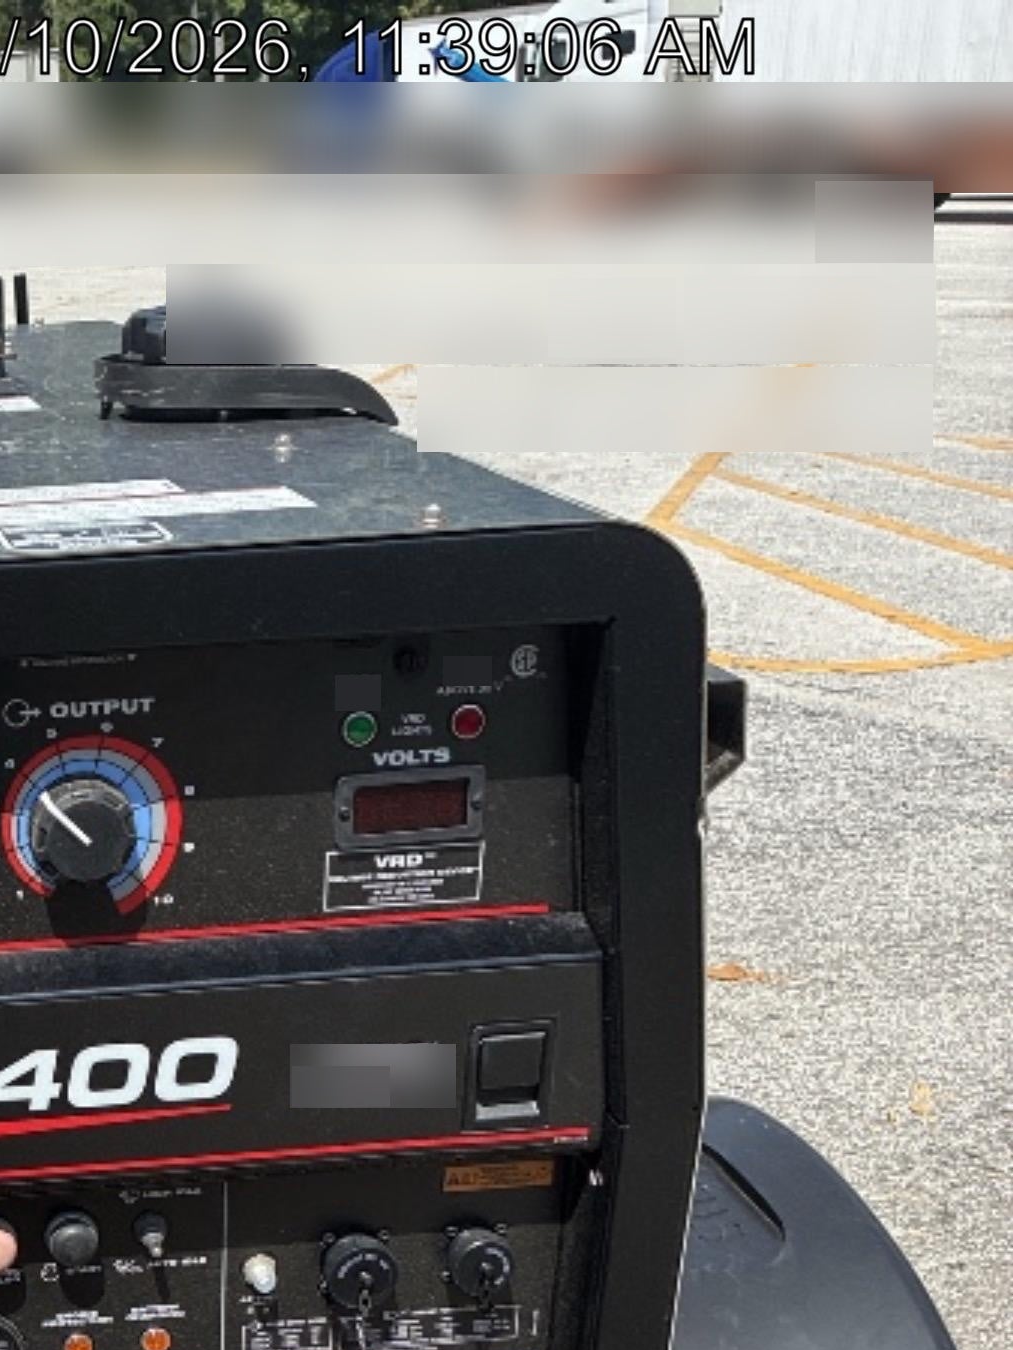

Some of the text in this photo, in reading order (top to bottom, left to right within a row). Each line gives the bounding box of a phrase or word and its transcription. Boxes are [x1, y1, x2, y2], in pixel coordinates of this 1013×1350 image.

[49, 697, 155, 719] OUTPUT
[373, 748, 450, 766] VOLTS
[153, 893, 174, 906] 10
